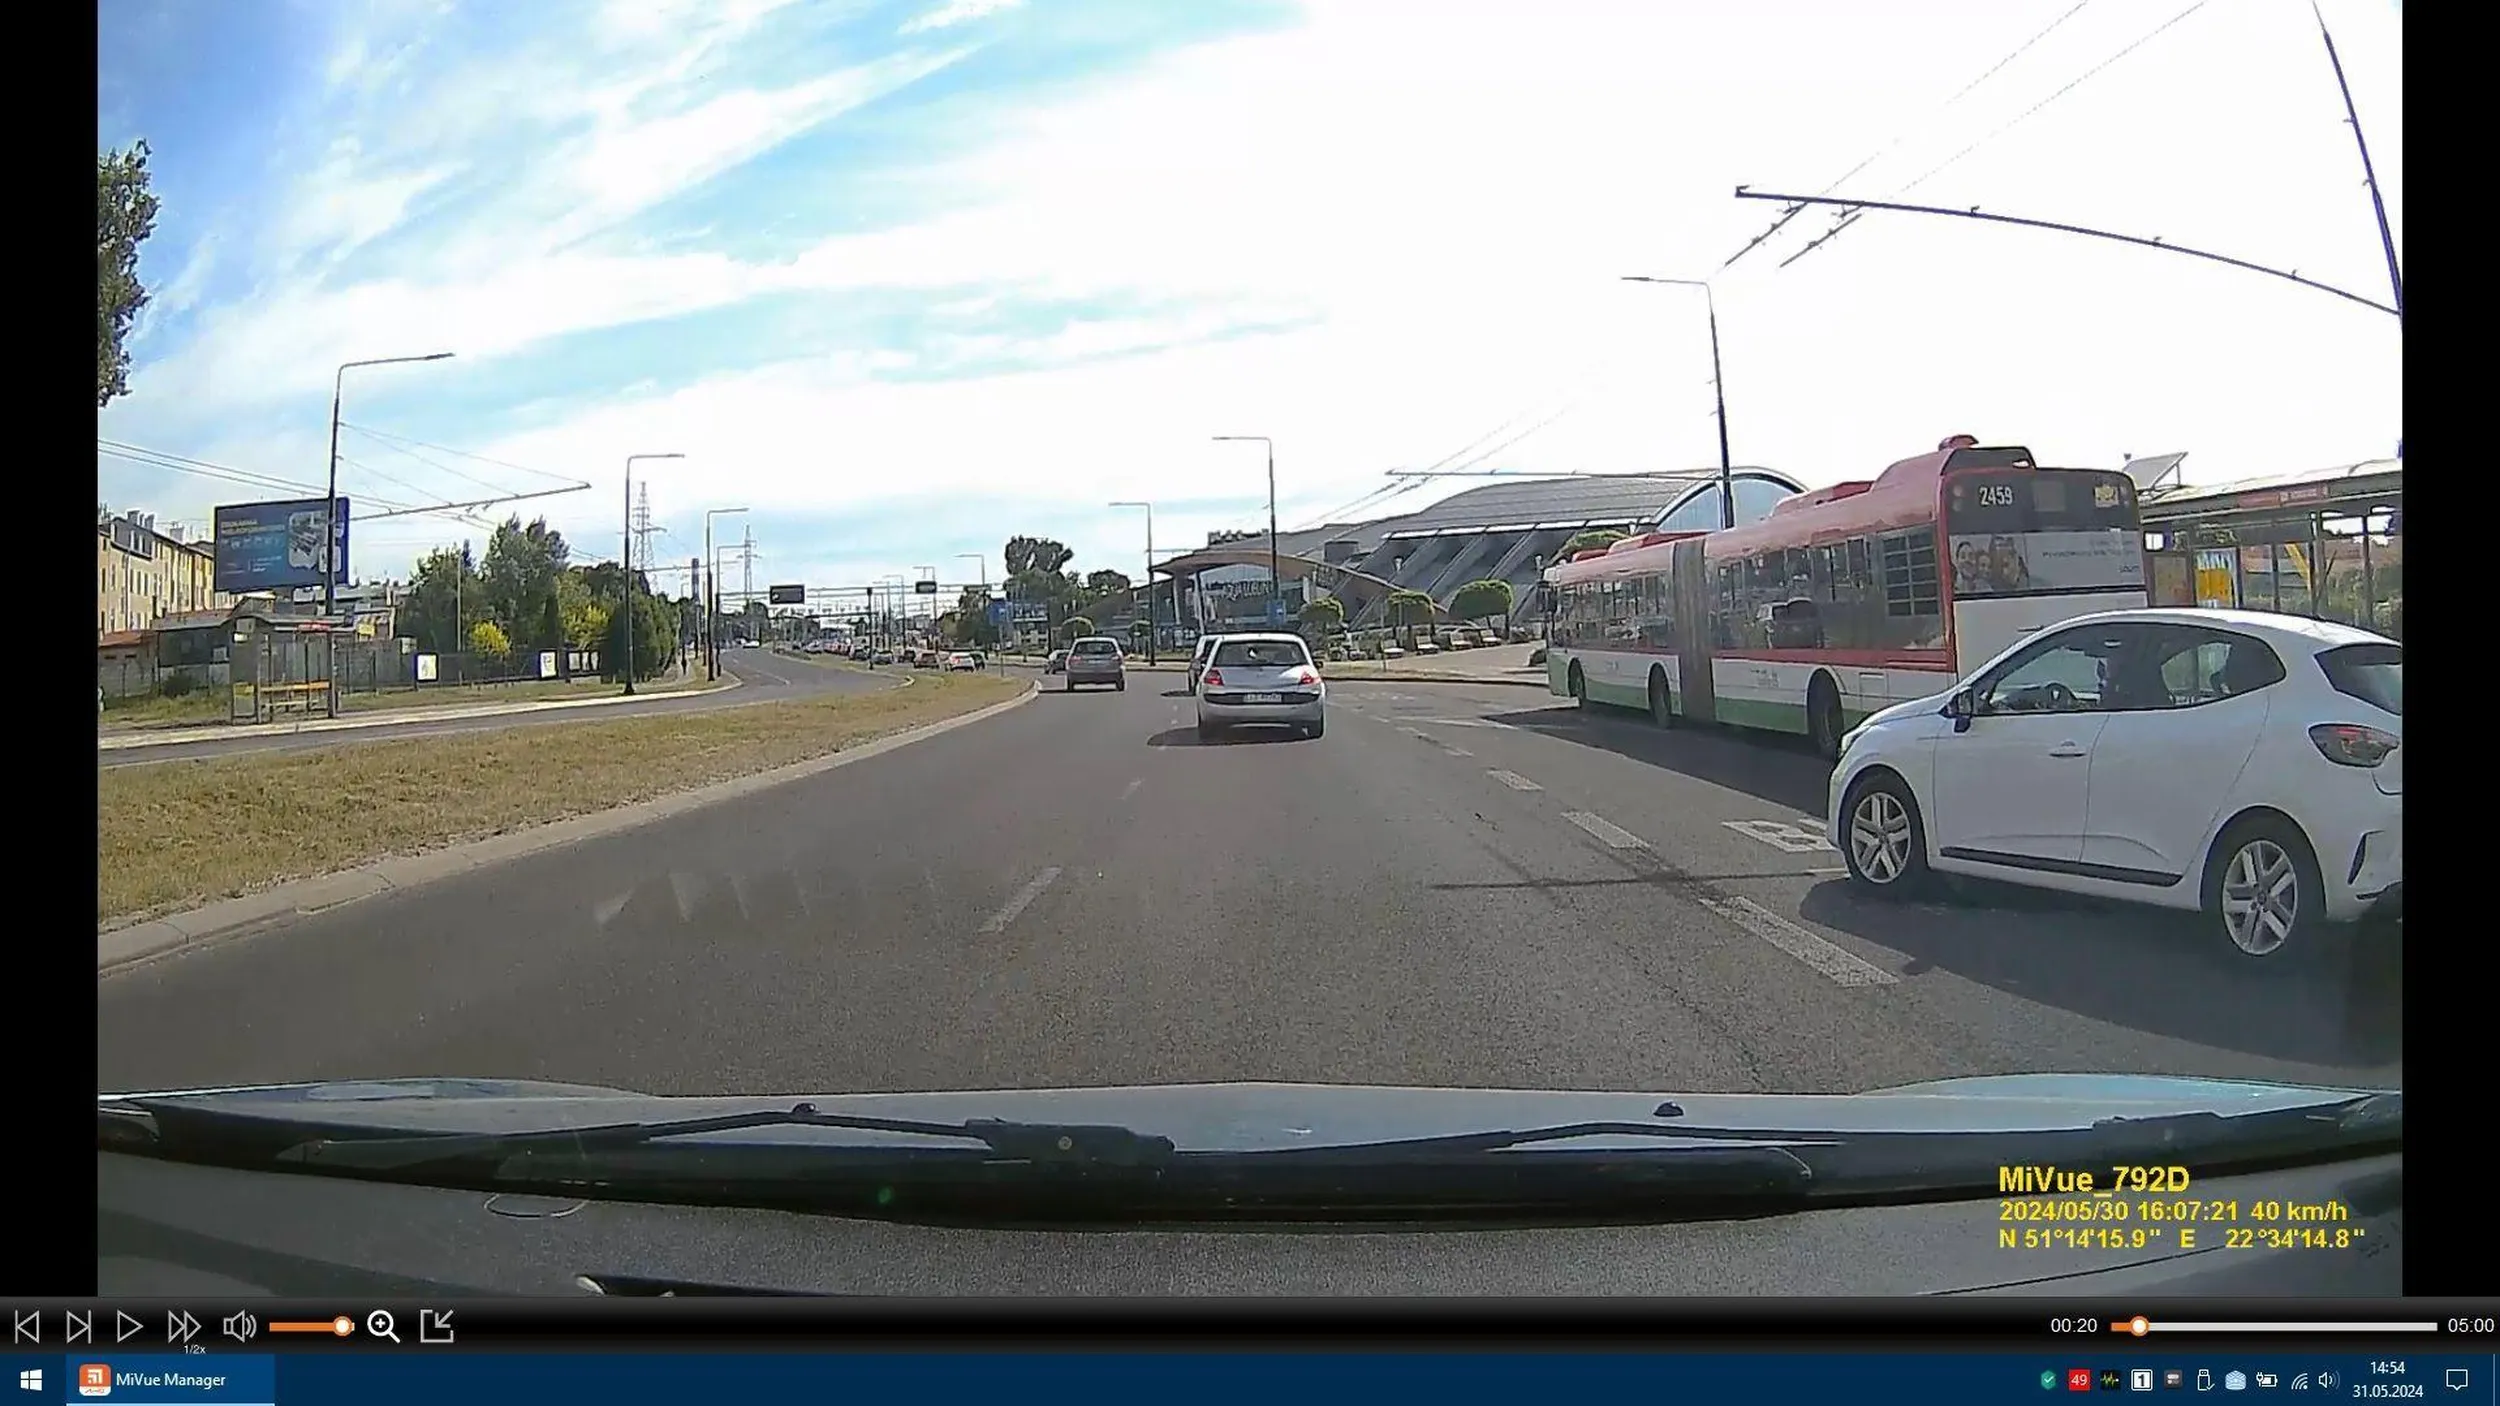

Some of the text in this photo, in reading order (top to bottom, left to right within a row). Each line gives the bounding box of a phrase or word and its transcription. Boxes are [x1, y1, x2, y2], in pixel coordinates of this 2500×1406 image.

[1979, 486, 2013, 505] 2459
[2050, 1318, 2098, 1333] 00:20
[2447, 1318, 2495, 1333] 05:00
[184, 1345, 206, 1355] 1/2x
[2370, 1361, 2406, 1375] 14:54
[116, 1372, 226, 1390] MiVue Manager
[2071, 1374, 2088, 1387] 49
[2353, 1384, 2424, 1398] 31.05.2024
